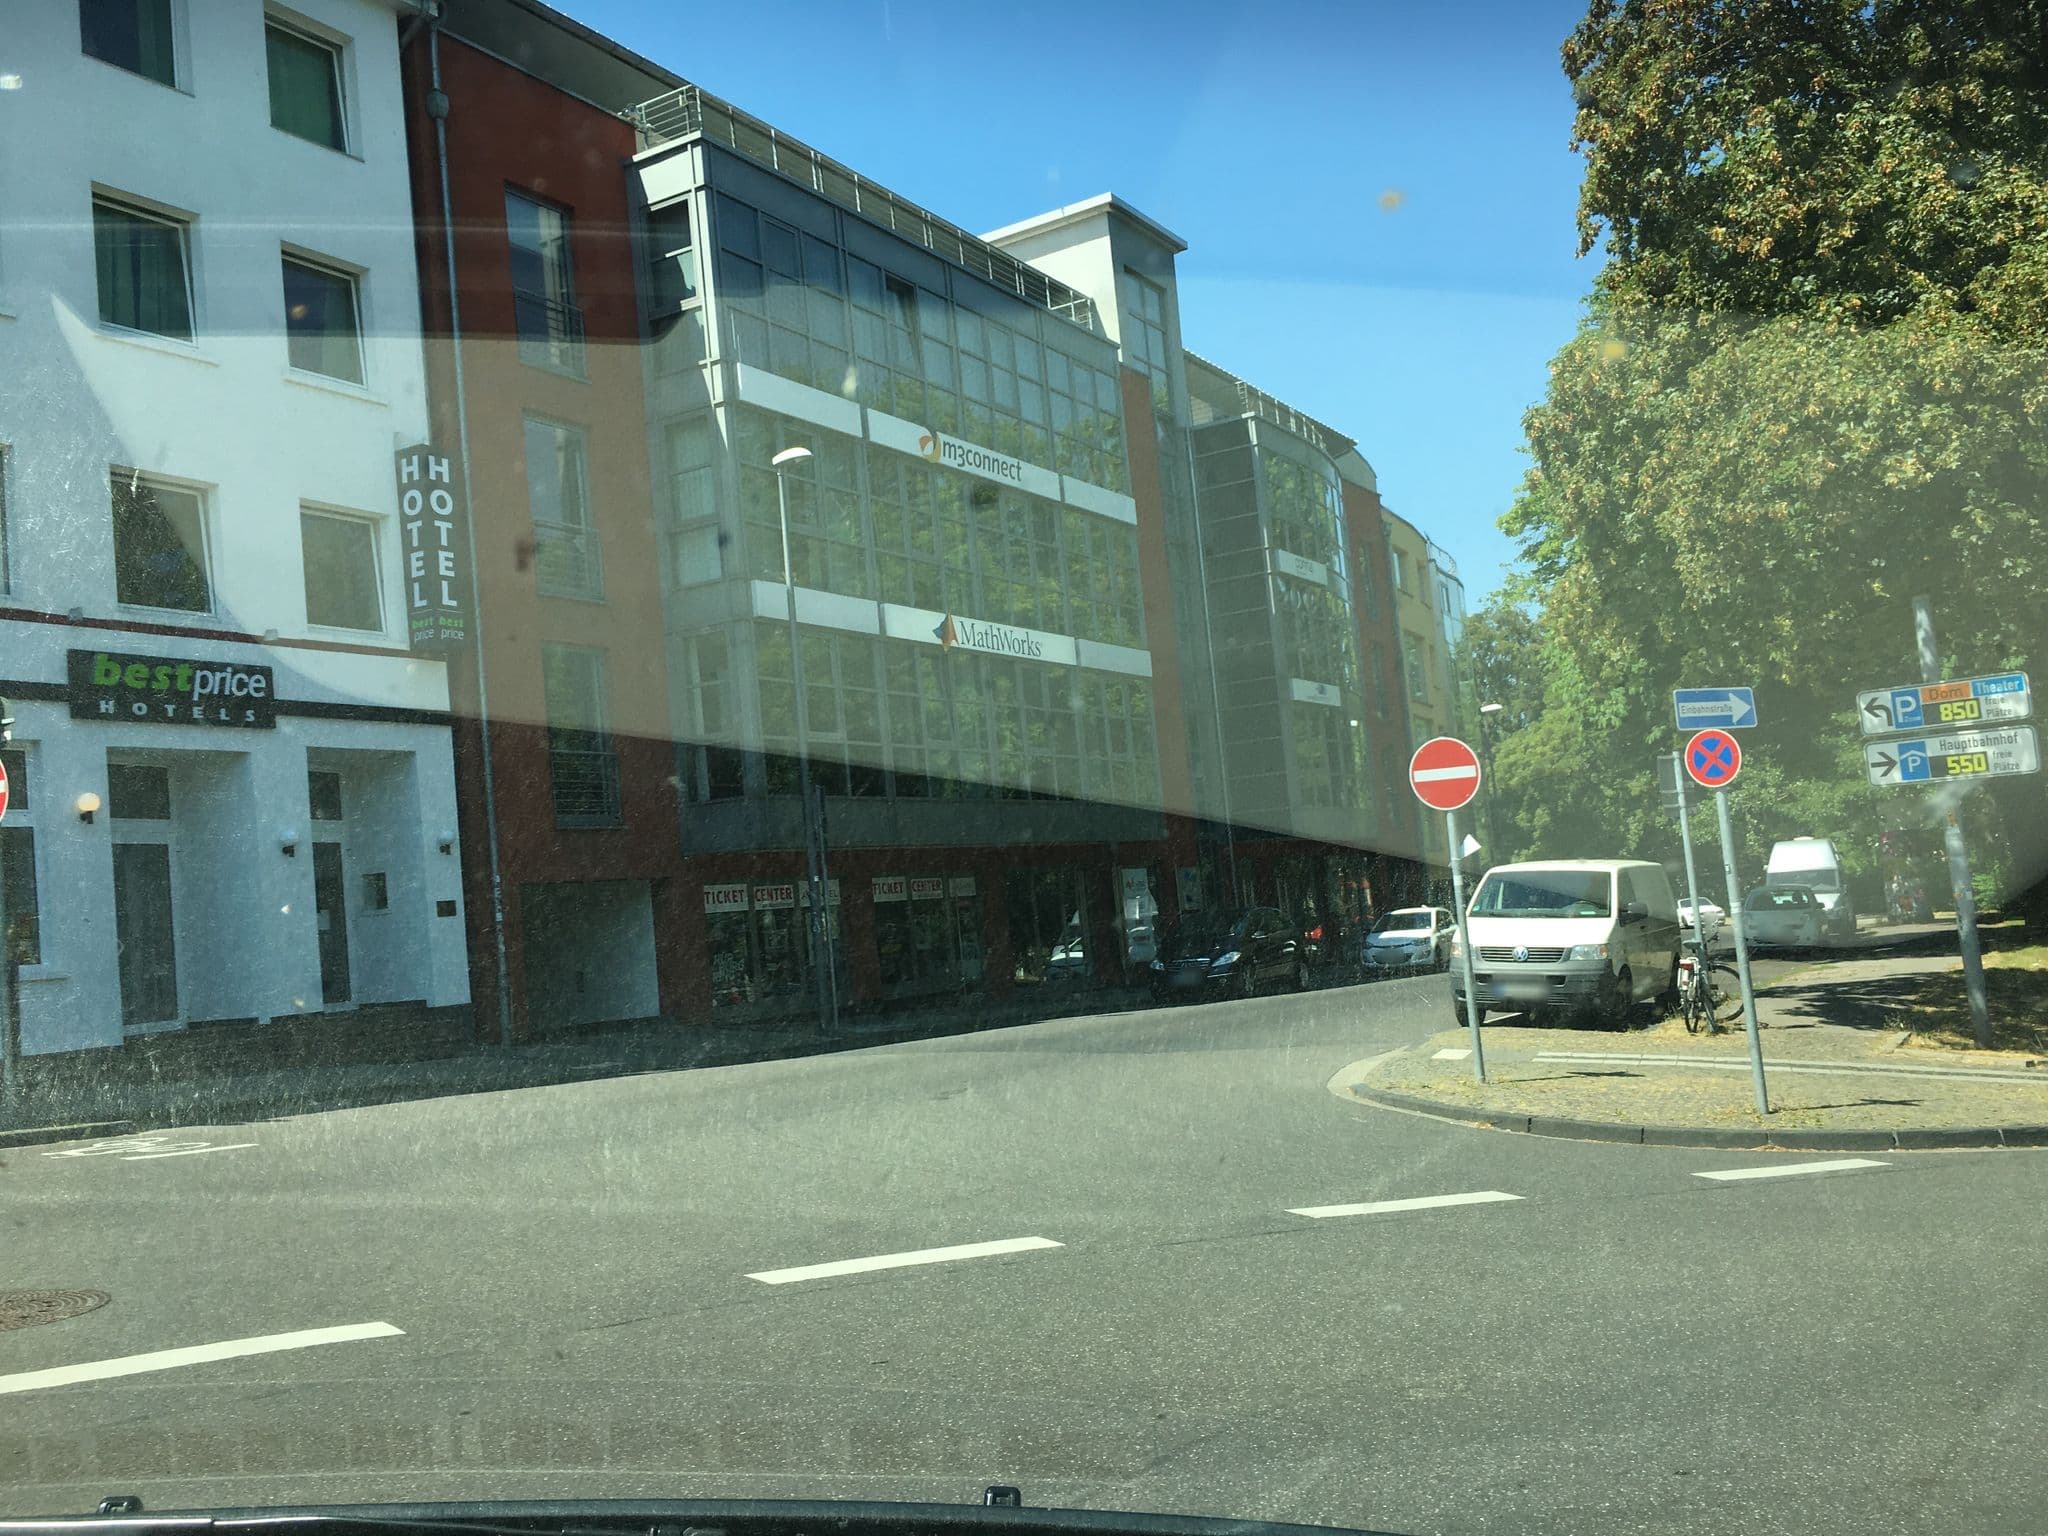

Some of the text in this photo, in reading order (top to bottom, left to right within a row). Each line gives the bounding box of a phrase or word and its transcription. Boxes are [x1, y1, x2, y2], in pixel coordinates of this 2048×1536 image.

[942, 439, 1023, 482] m3connect
[401, 455, 427, 608] HOTEL
[428, 455, 458, 608] HOTEL
[439, 616, 465, 628] best
[413, 628, 435, 643] price
[440, 628, 465, 642] price
[959, 619, 1042, 658] MathWorks
[1929, 686, 1964, 701] Dom
[1975, 679, 2020, 695] Theater
[98, 698, 257, 724] HOTELS
[1939, 700, 1978, 721] 850
[1939, 731, 2019, 752] Hauptbahnhof
[1946, 753, 1988, 776] 550
[1992, 750, 2014, 760] freie
[704, 887, 745, 905] TICKET
[754, 886, 793, 903] CENTER
[872, 880, 904, 896] TICKET
[911, 878, 943, 892] CENTER
